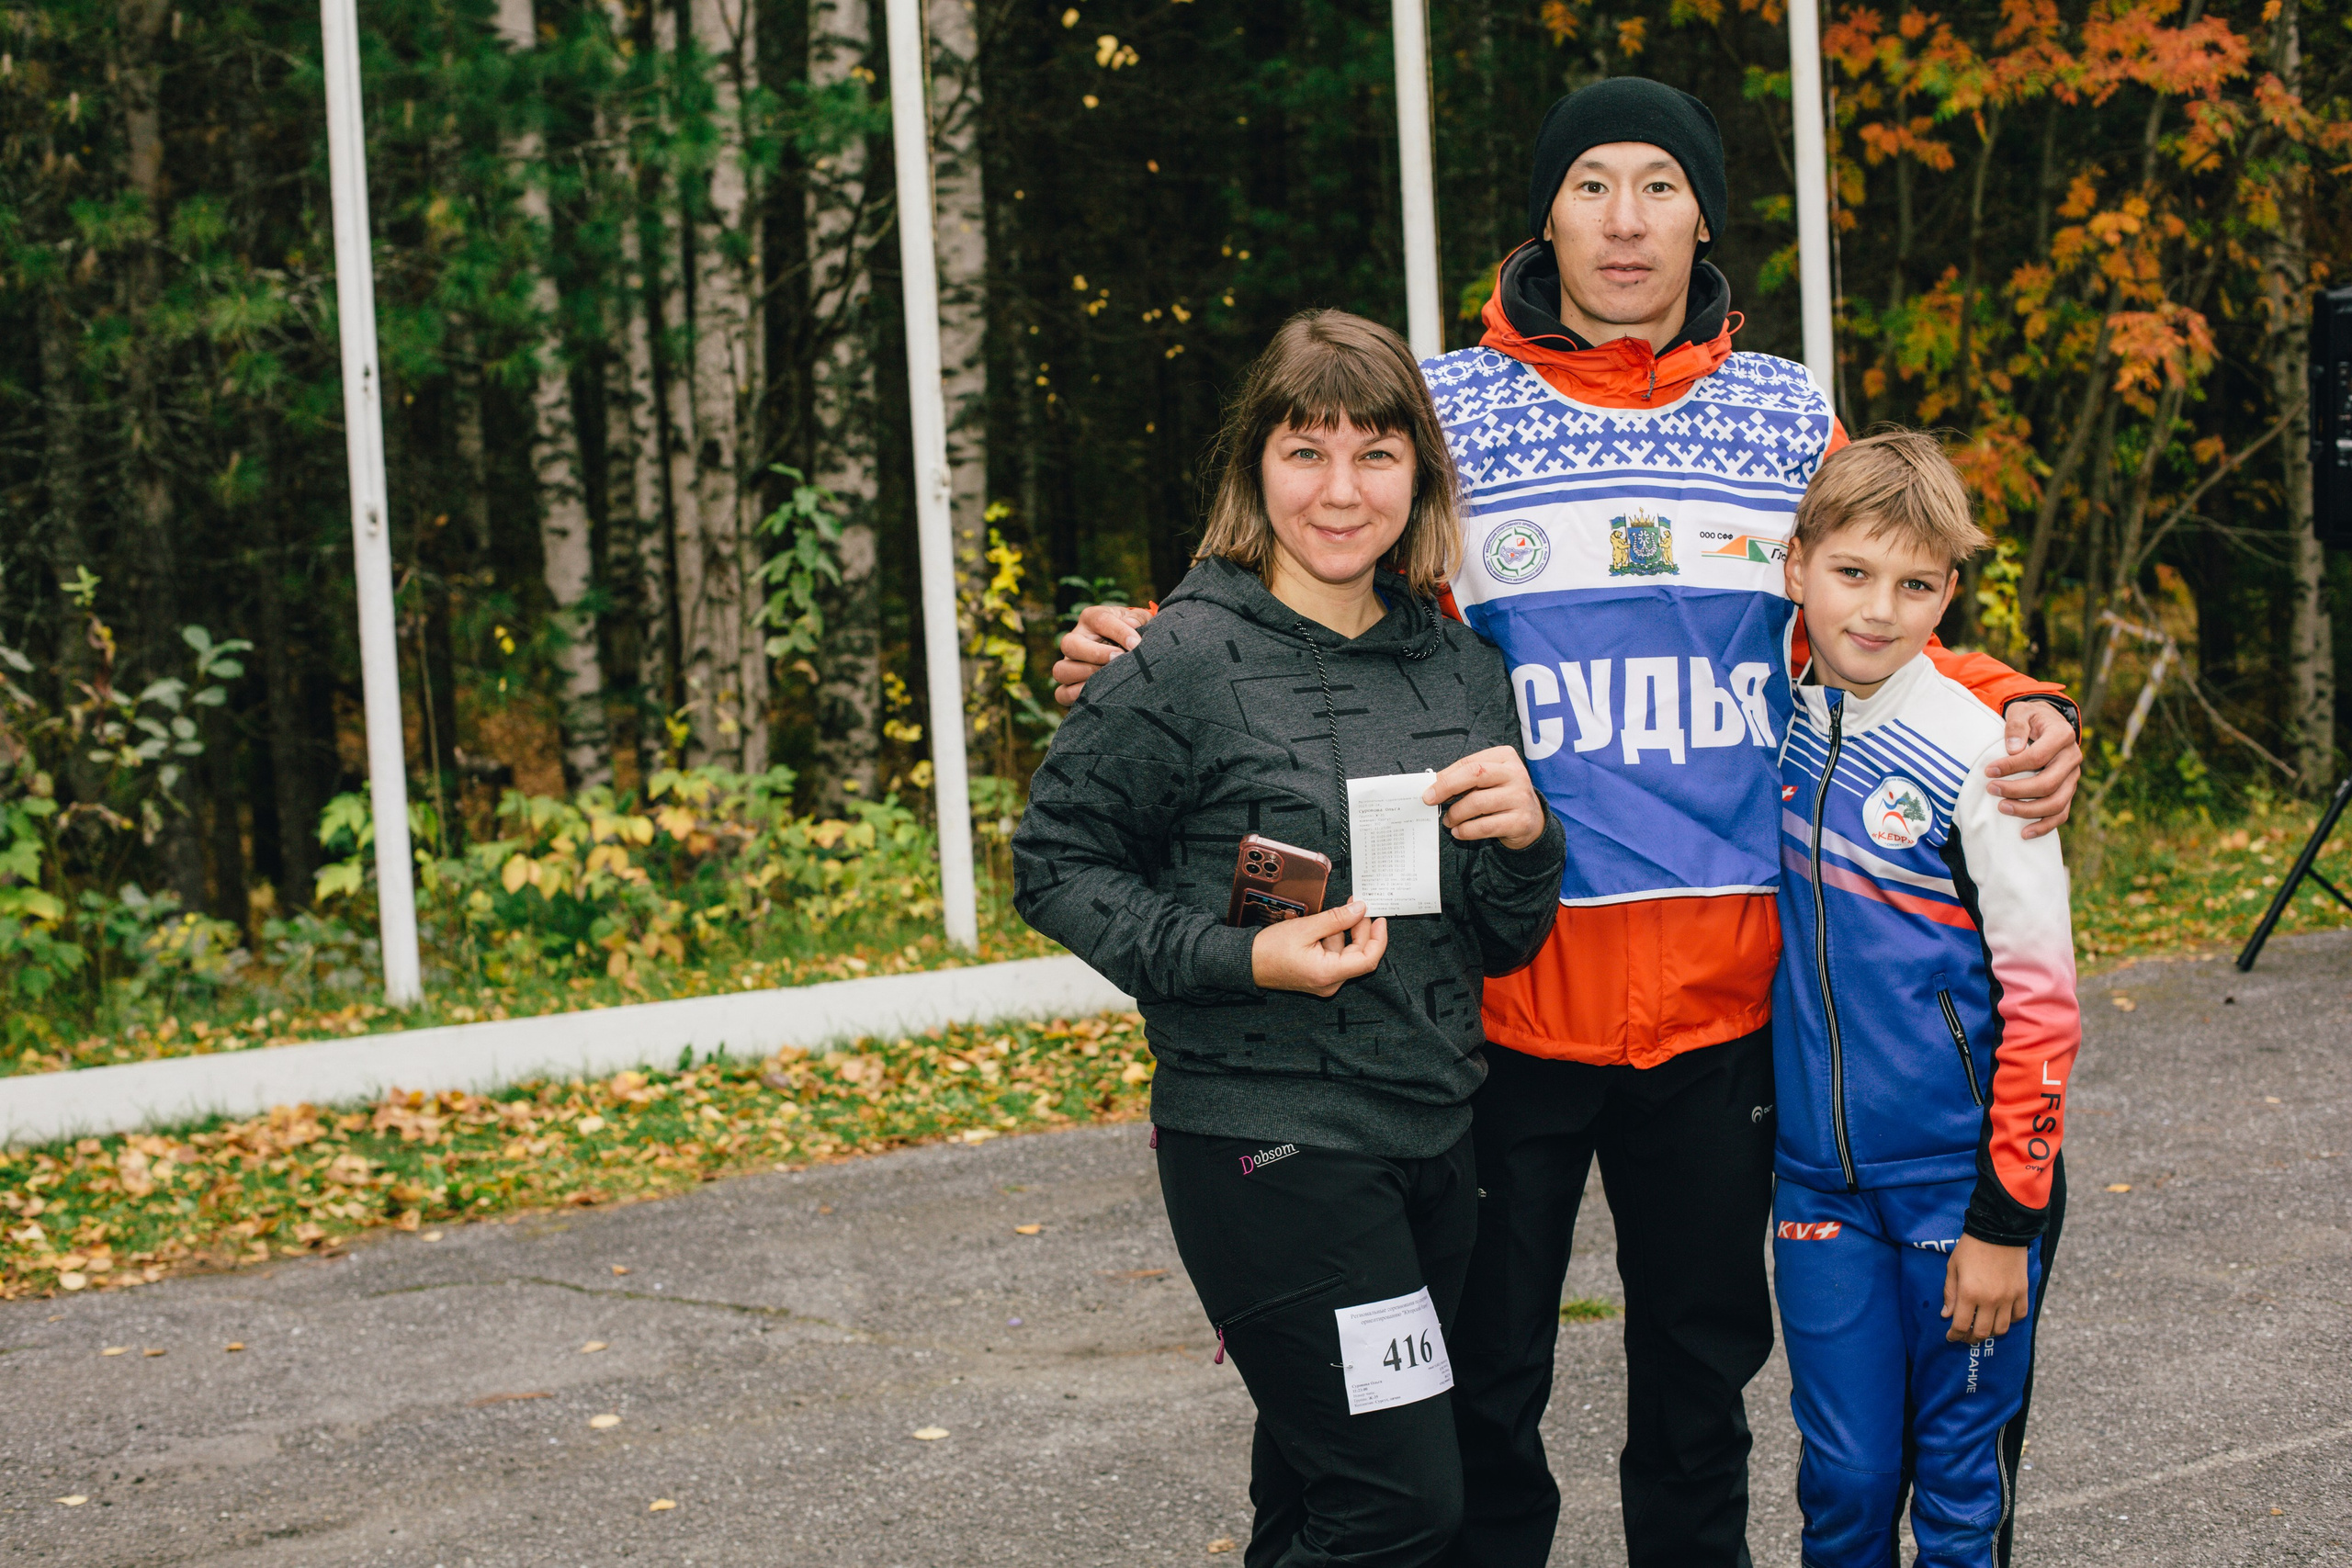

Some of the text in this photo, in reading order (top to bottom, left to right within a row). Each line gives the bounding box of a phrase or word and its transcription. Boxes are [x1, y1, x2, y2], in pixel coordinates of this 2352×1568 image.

[1510, 656, 1777, 764] СУДЬЯ
[1238, 1144, 1297, 1175] Dobsom
[1384, 1328, 1432, 1371] 416
